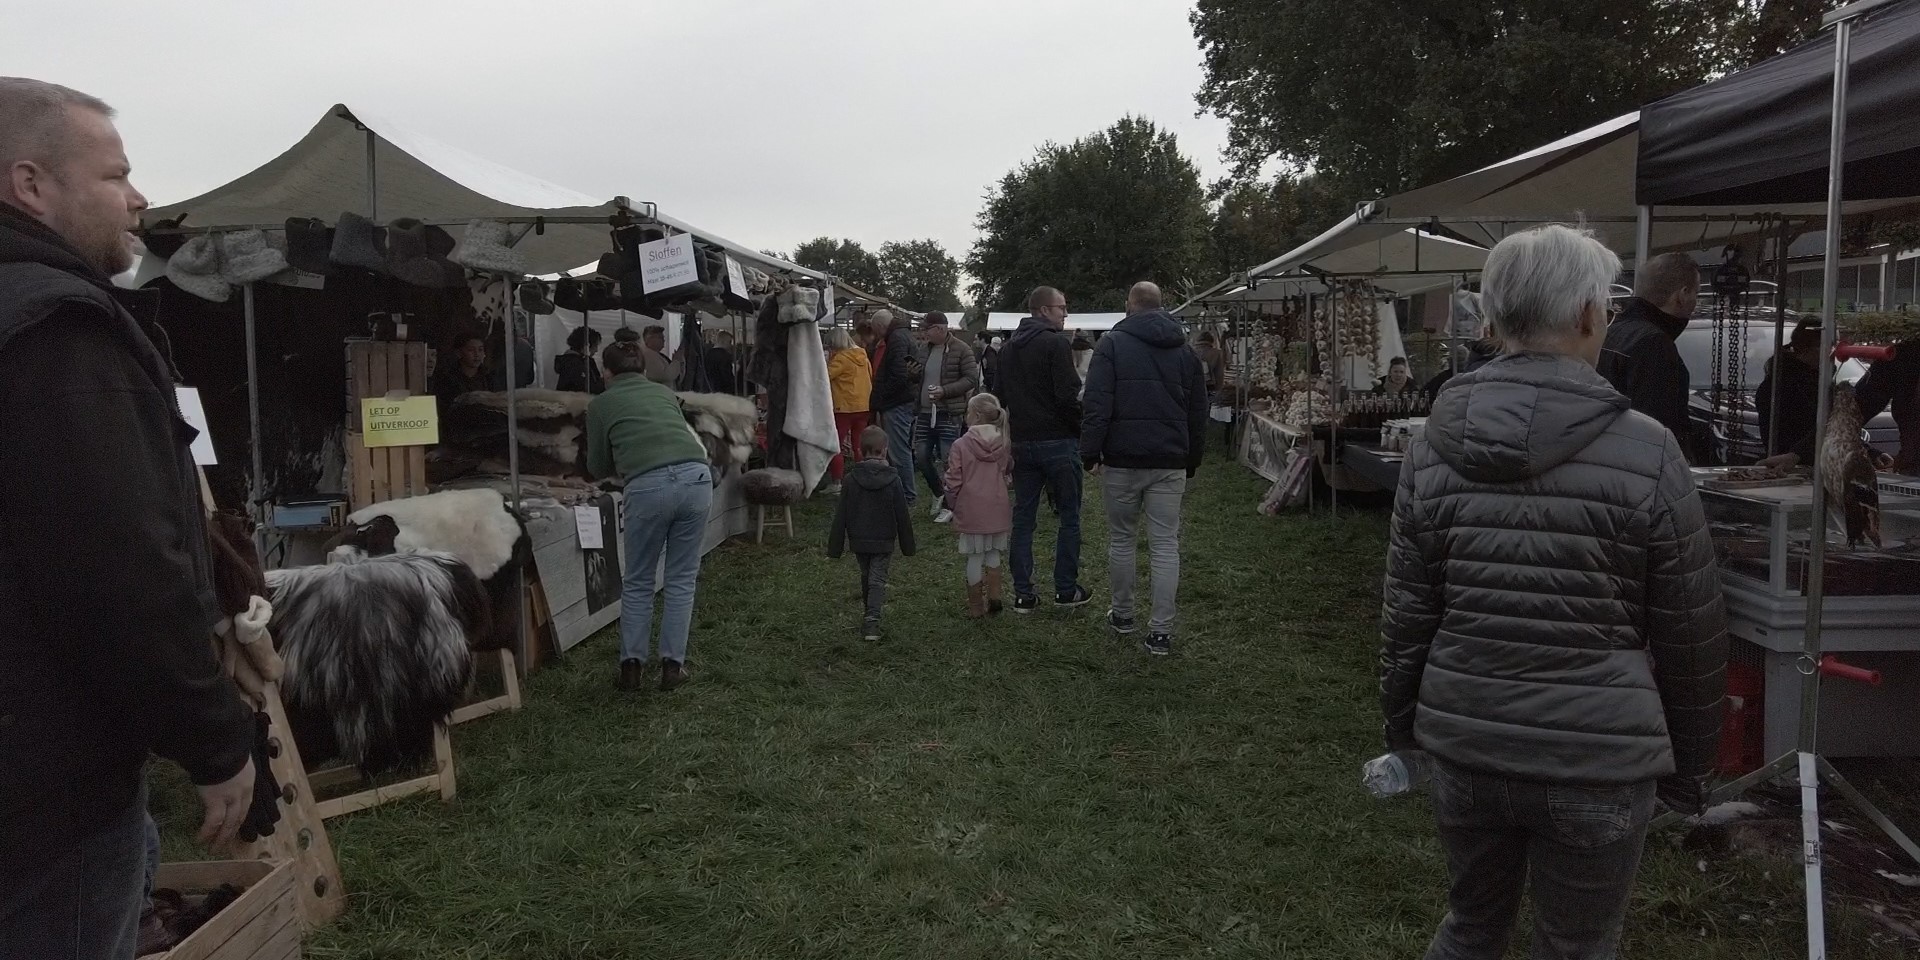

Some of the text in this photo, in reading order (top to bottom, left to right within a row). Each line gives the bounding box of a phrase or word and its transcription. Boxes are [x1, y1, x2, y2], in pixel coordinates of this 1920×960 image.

[649, 246, 682, 262] Sloffen
[369, 406, 400, 416] LET OP
[370, 419, 429, 430] UITVERKOOP
